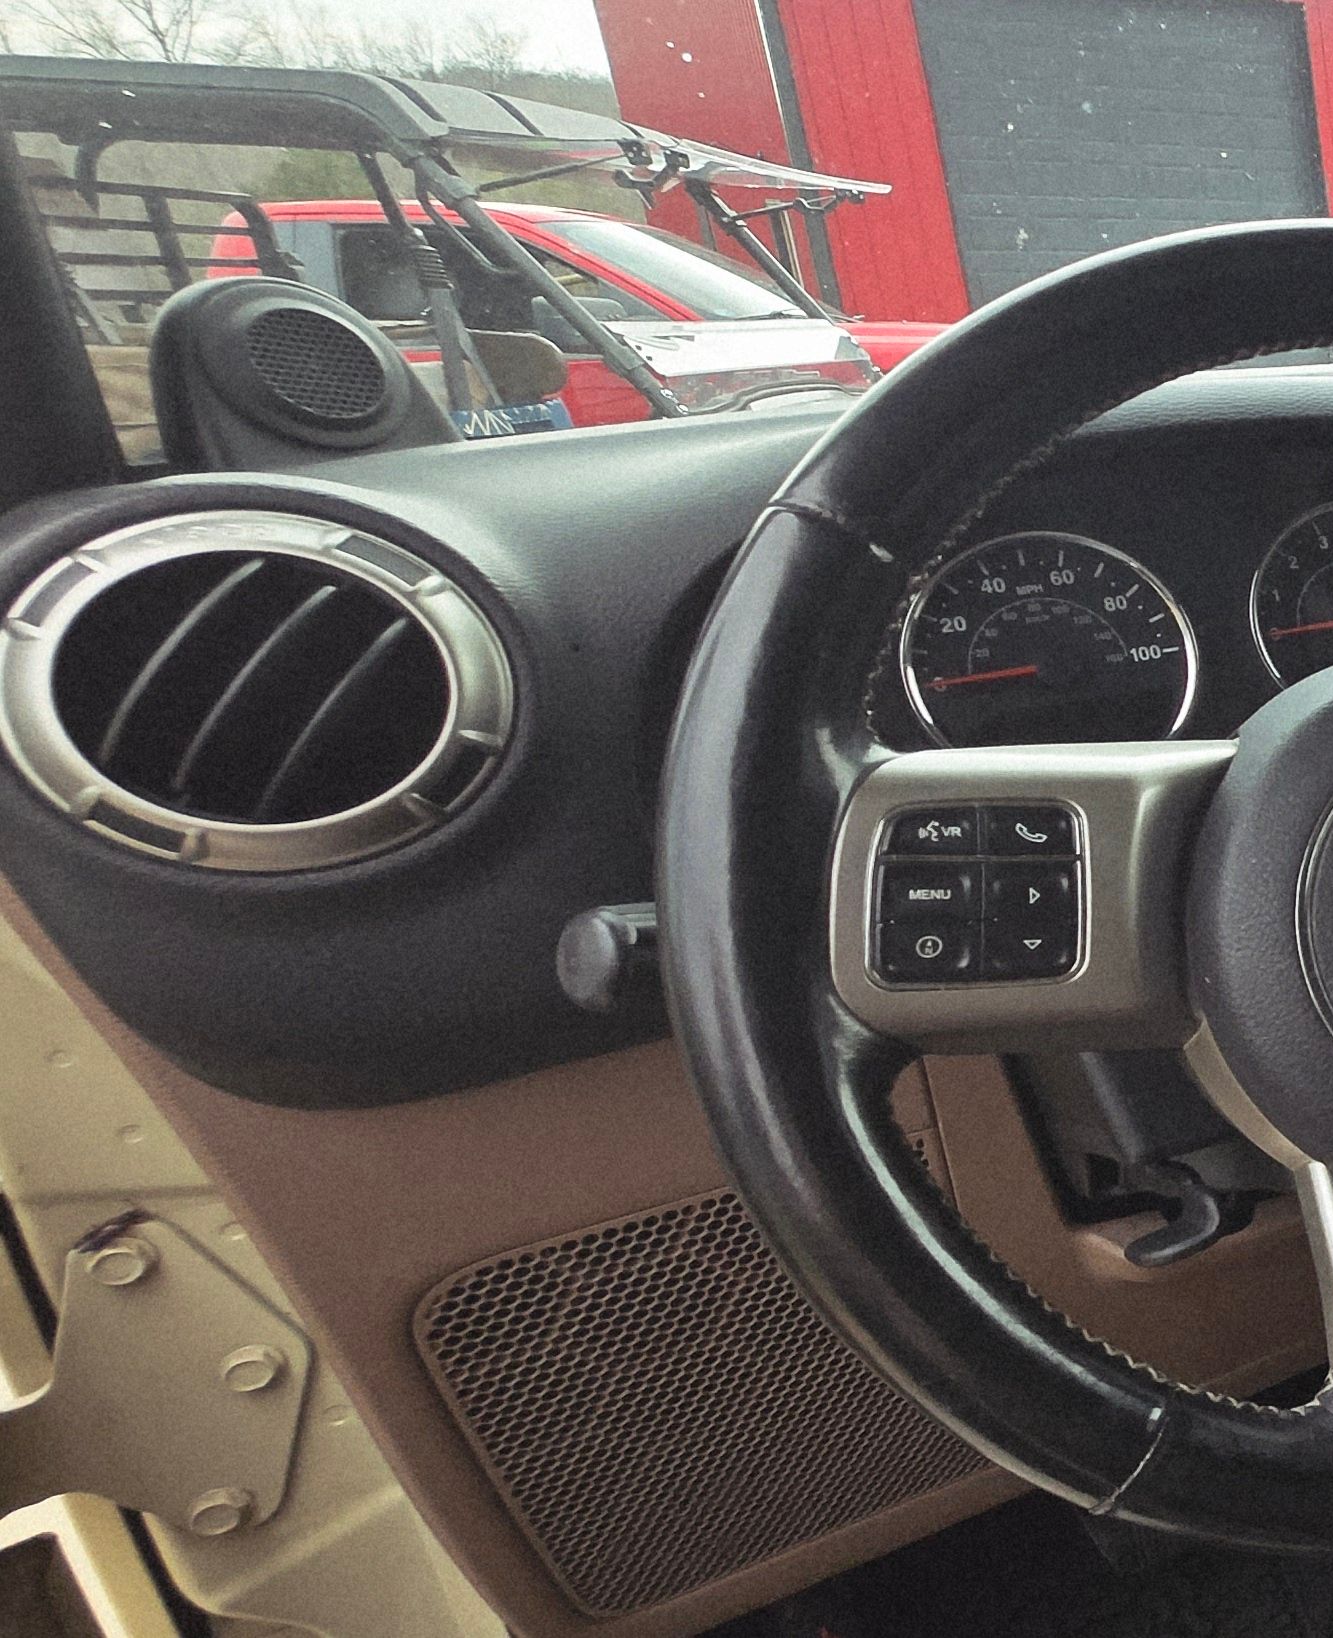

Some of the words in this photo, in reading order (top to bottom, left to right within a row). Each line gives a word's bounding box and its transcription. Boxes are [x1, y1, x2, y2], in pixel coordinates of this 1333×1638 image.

[1318, 535, 1329, 549] 3
[1287, 556, 1300, 569] 2
[1050, 569, 1075, 586] 60
[981, 577, 1006, 594] 40
[1016, 583, 1043, 596] MPH
[1103, 595, 1127, 612] 80
[940, 615, 967, 633] 20
[1129, 645, 1161, 663] 100
[941, 825, 962, 838] VR
[909, 889, 951, 900] MENU
